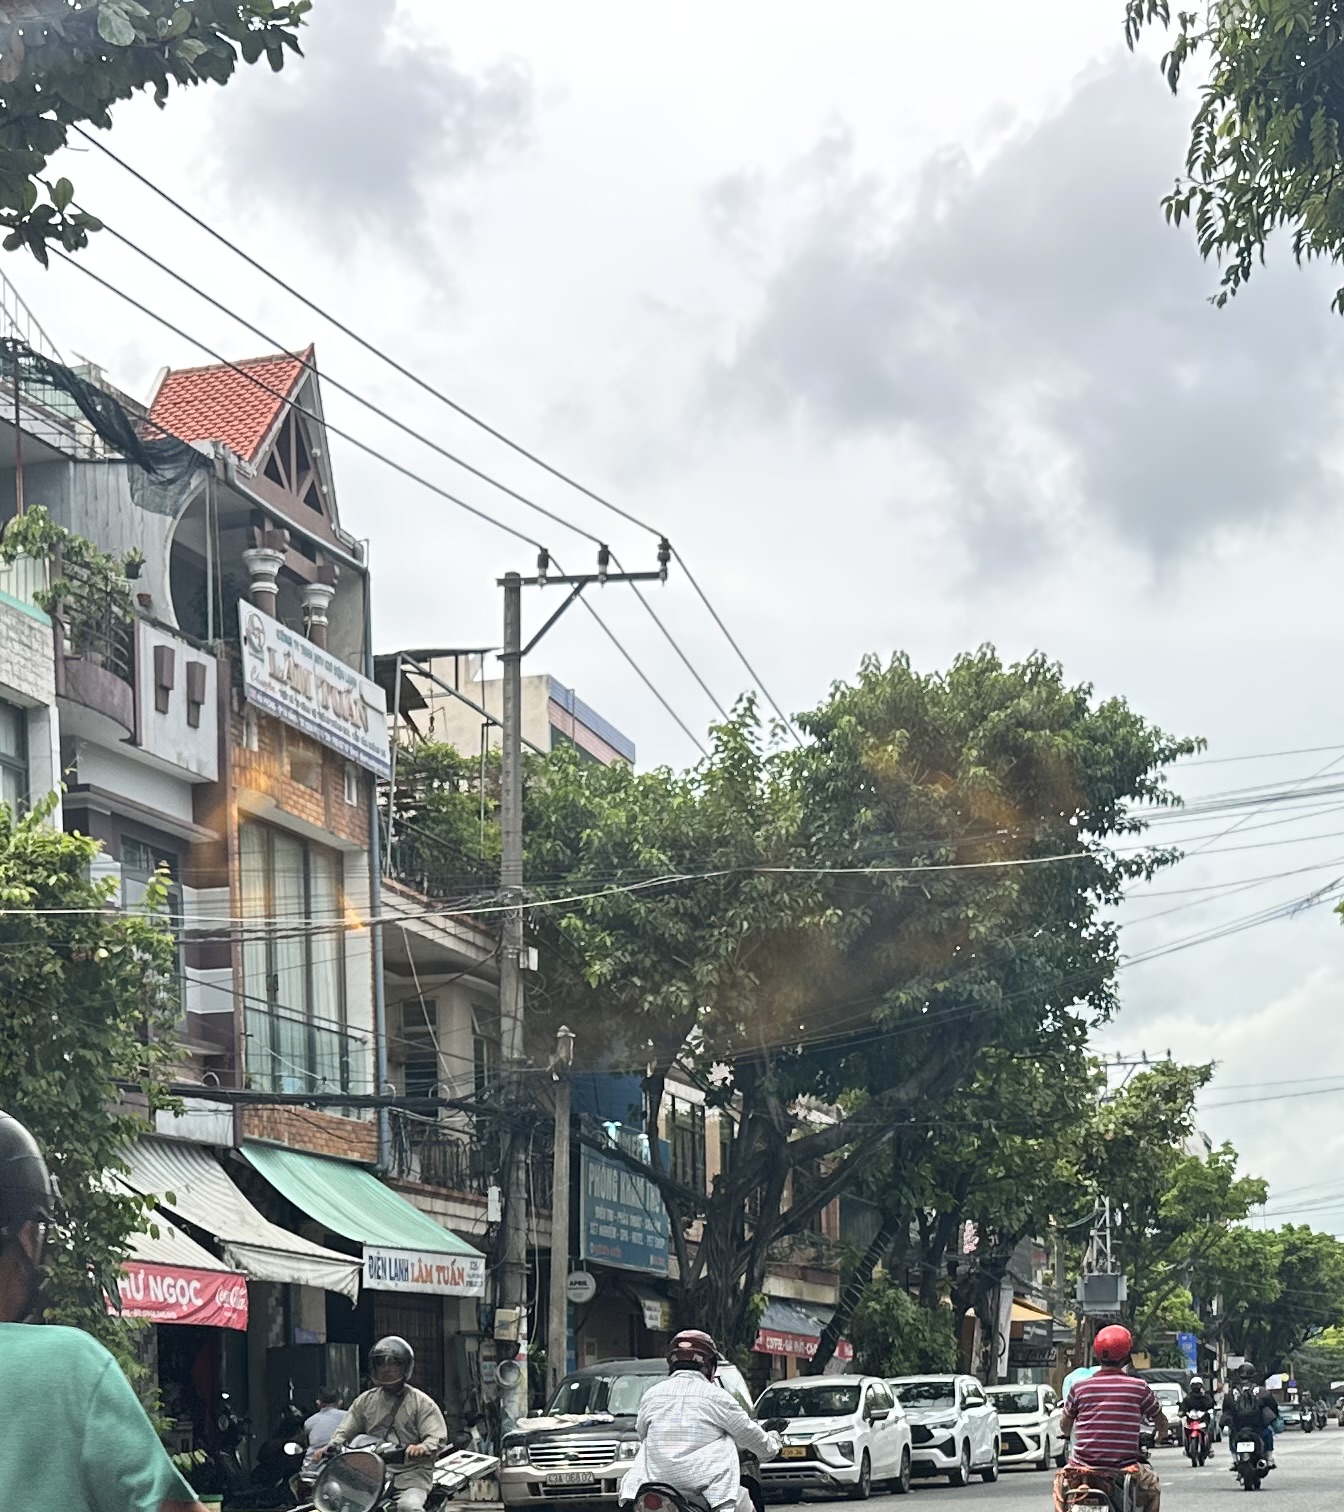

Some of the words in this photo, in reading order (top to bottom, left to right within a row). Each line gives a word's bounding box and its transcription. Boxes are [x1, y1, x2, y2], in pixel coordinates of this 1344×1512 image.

[410, 1257, 433, 1284] LÂM
[435, 1258, 465, 1286] TUẤN
[116, 1269, 145, 1301] HƯ
[148, 1275, 203, 1311] NGỌC
